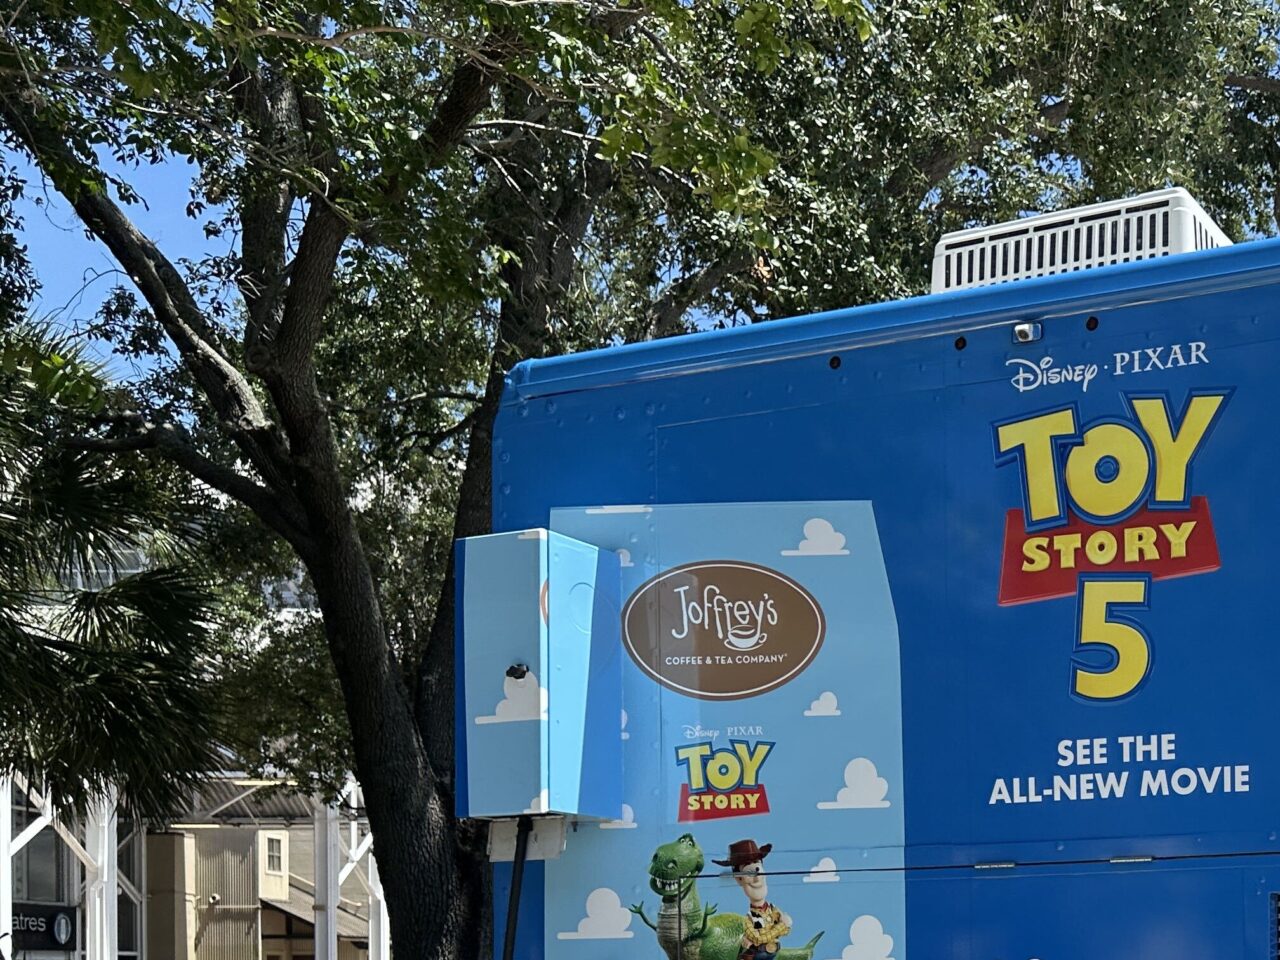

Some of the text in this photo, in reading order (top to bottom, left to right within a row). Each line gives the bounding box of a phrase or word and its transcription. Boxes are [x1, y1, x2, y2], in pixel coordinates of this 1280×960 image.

[1113, 341, 1209, 376] PIXAR
[994, 391, 1230, 527] TOY
[1022, 521, 1197, 572] STORY
[672, 585, 777, 640] Joffrey's
[665, 656, 702, 665] COFFEE
[705, 656, 712, 665] &
[715, 655, 733, 664] TEA
[1072, 577, 1152, 703] 5
[727, 726, 763, 736] PIXAR
[1057, 733, 1176, 767] SEE THE
[676, 740, 774, 792] TOY
[988, 765, 1250, 805] ALL-NEW MOVIE
[687, 793, 760, 810] STORY
